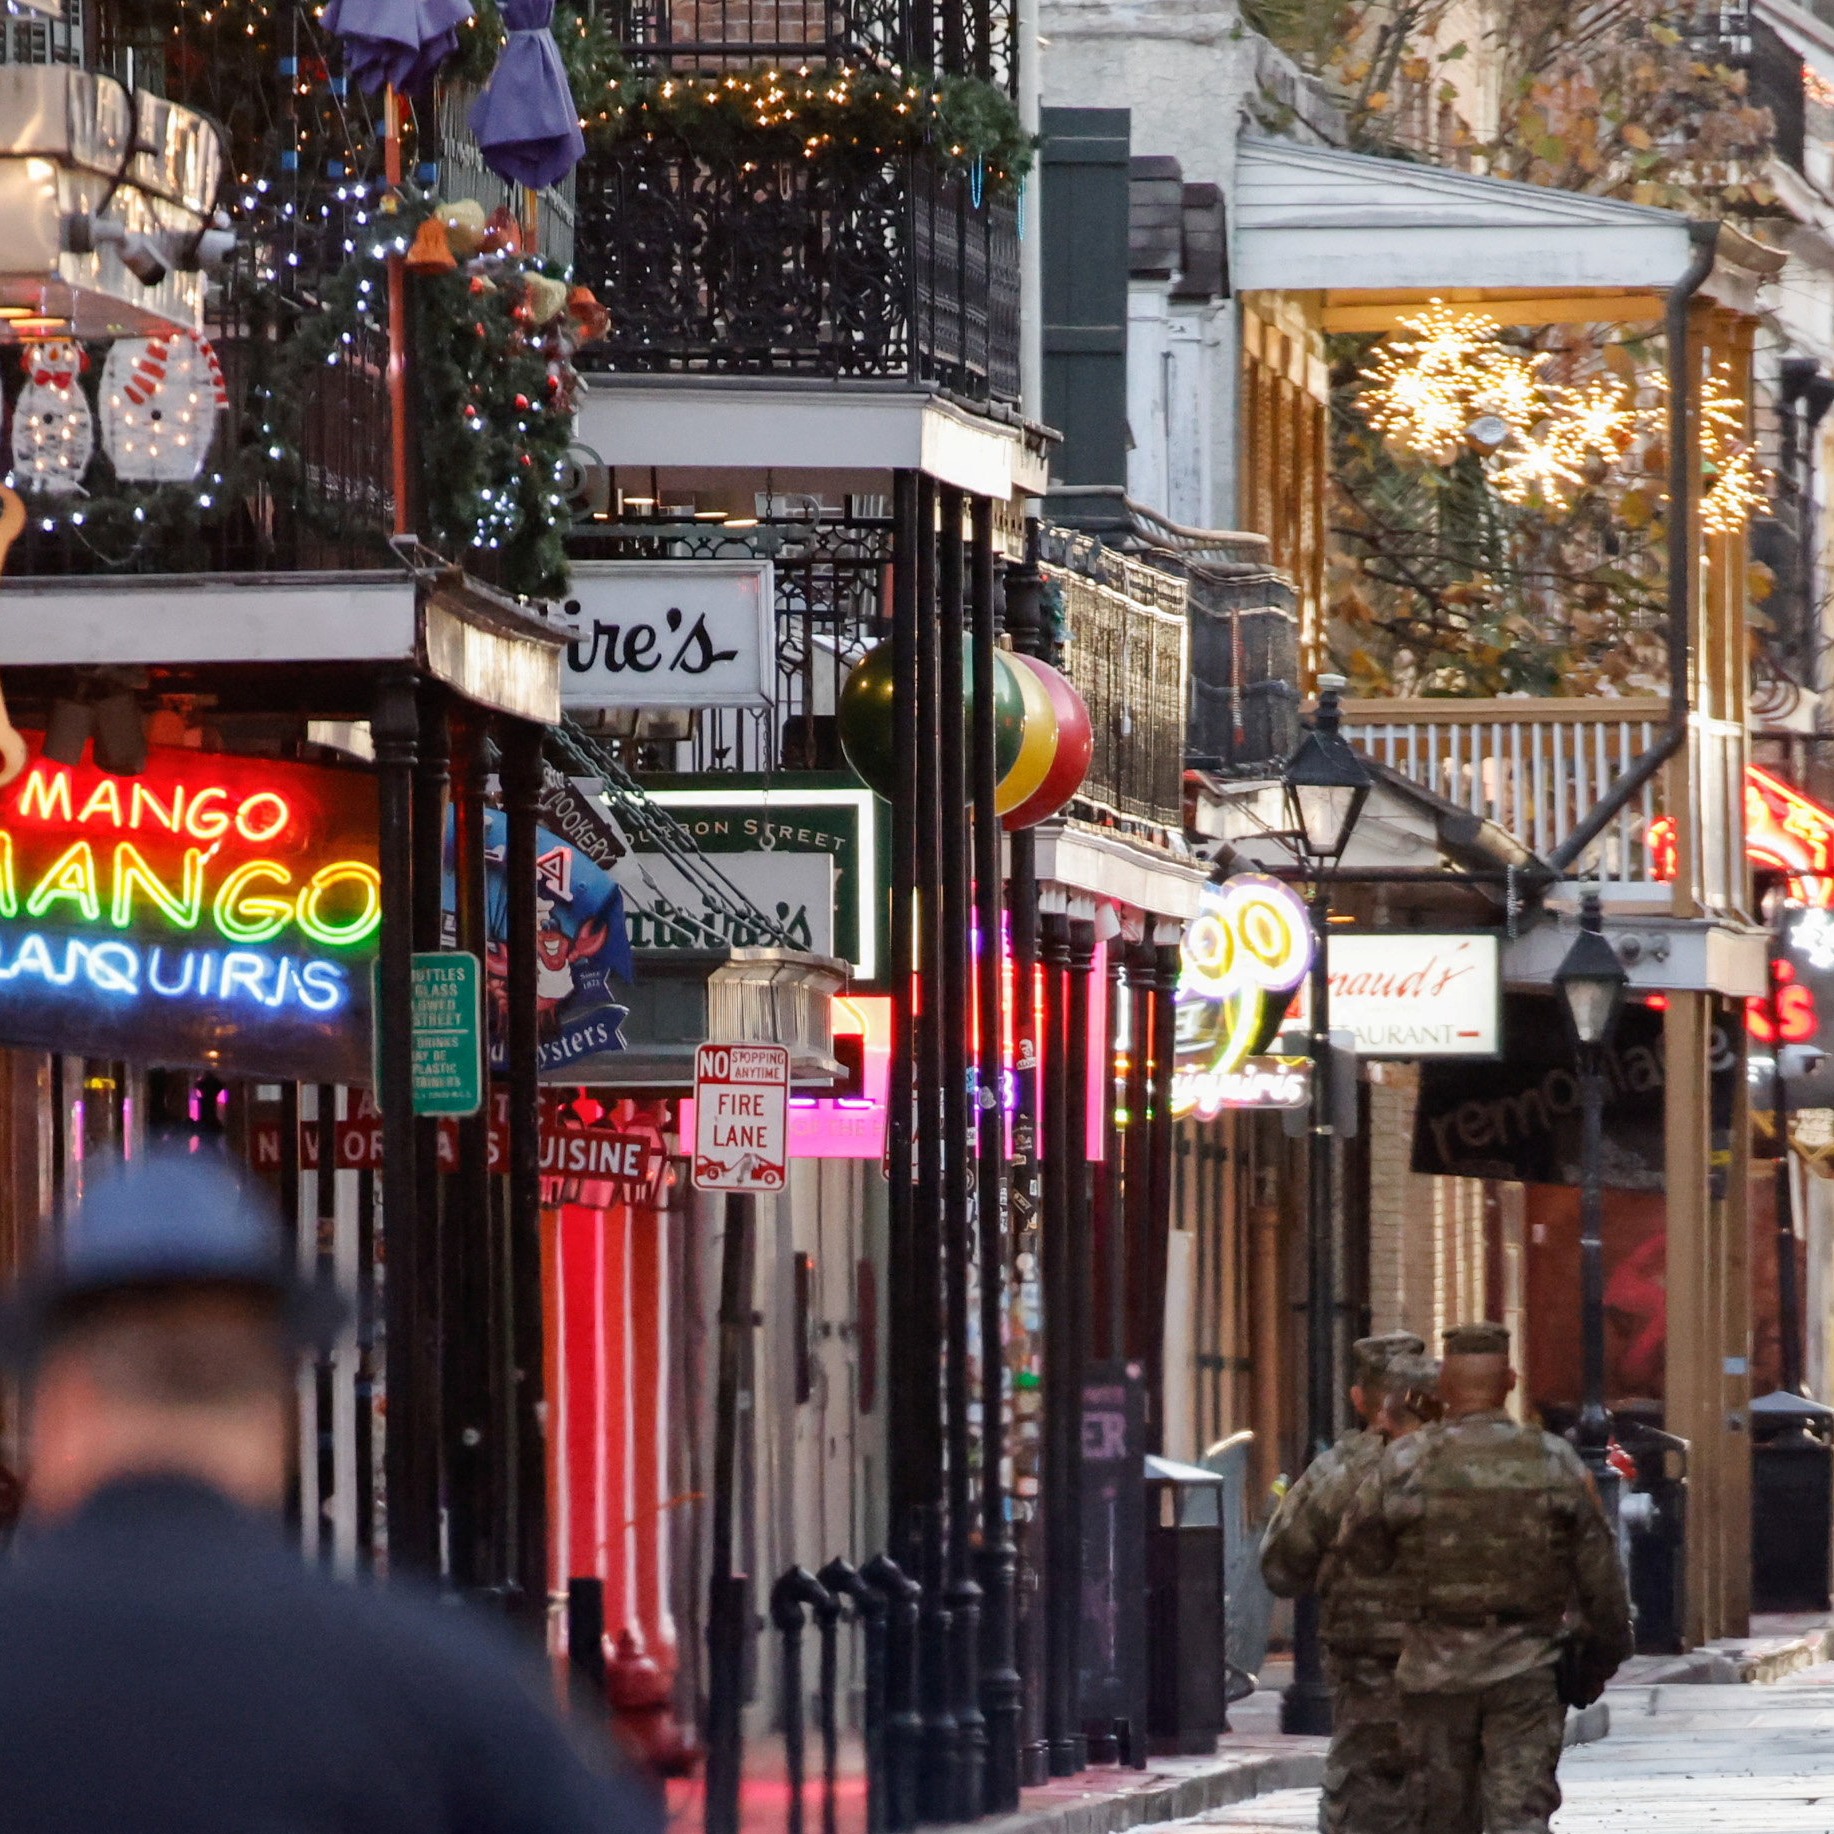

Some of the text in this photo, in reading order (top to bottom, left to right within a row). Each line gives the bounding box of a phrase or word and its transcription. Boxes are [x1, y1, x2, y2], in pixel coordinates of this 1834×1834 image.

[565, 600, 738, 674] ire's
[18, 770, 289, 842] MANGO
[538, 1020, 609, 1070] ysters
[699, 1050, 785, 1079] NO STOPPING
[734, 1066, 780, 1080] ANYTIME
[718, 1093, 765, 1116] FIRE
[713, 1125, 768, 1149] LANE
[538, 1136, 644, 1177] UISINE
